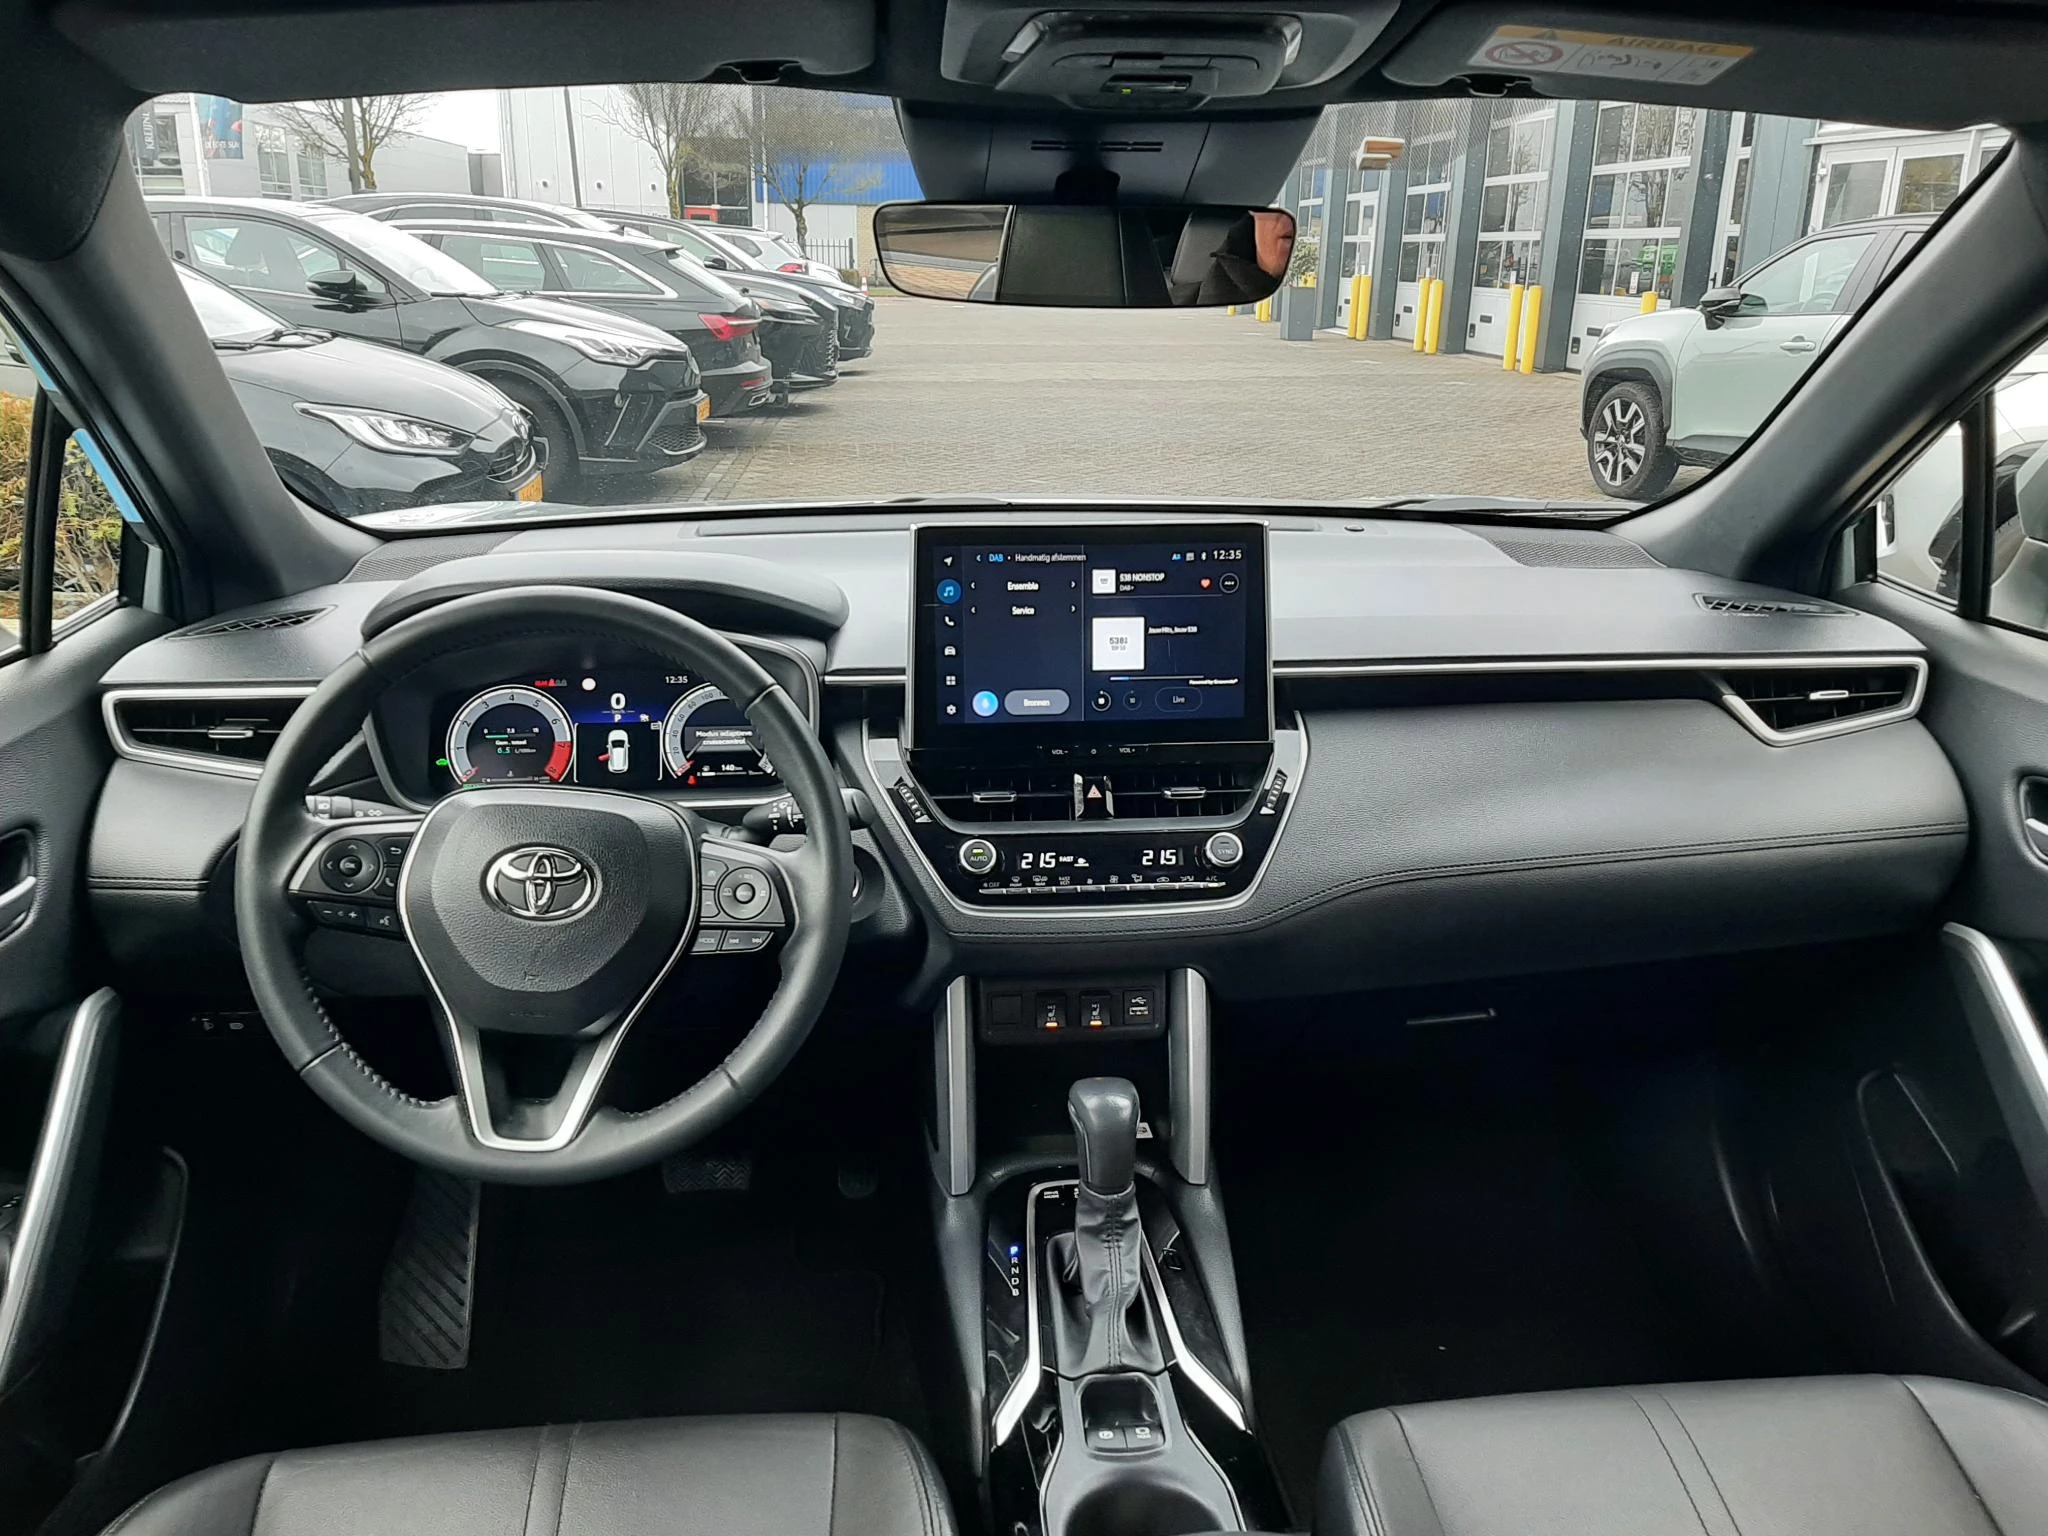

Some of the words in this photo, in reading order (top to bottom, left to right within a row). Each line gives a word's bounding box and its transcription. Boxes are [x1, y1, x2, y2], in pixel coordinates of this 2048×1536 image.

[989, 554, 1004, 562] DAB
[1015, 553, 1050, 563] Handmatig
[1213, 550, 1242, 559] 12:35
[1132, 573, 1165, 582] NONSTOP
[1007, 582, 1039, 590] Ensemble
[1012, 606, 1035, 615] Service
[665, 675, 688, 683] 12:35
[481, 700, 490, 709] 3
[533, 699, 541, 708] 5
[611, 692, 626, 710] 0
[614, 714, 621, 723] P
[721, 764, 735, 772] 140
[1010, 1246, 1018, 1255] P
[1012, 1277, 1019, 1285] D
